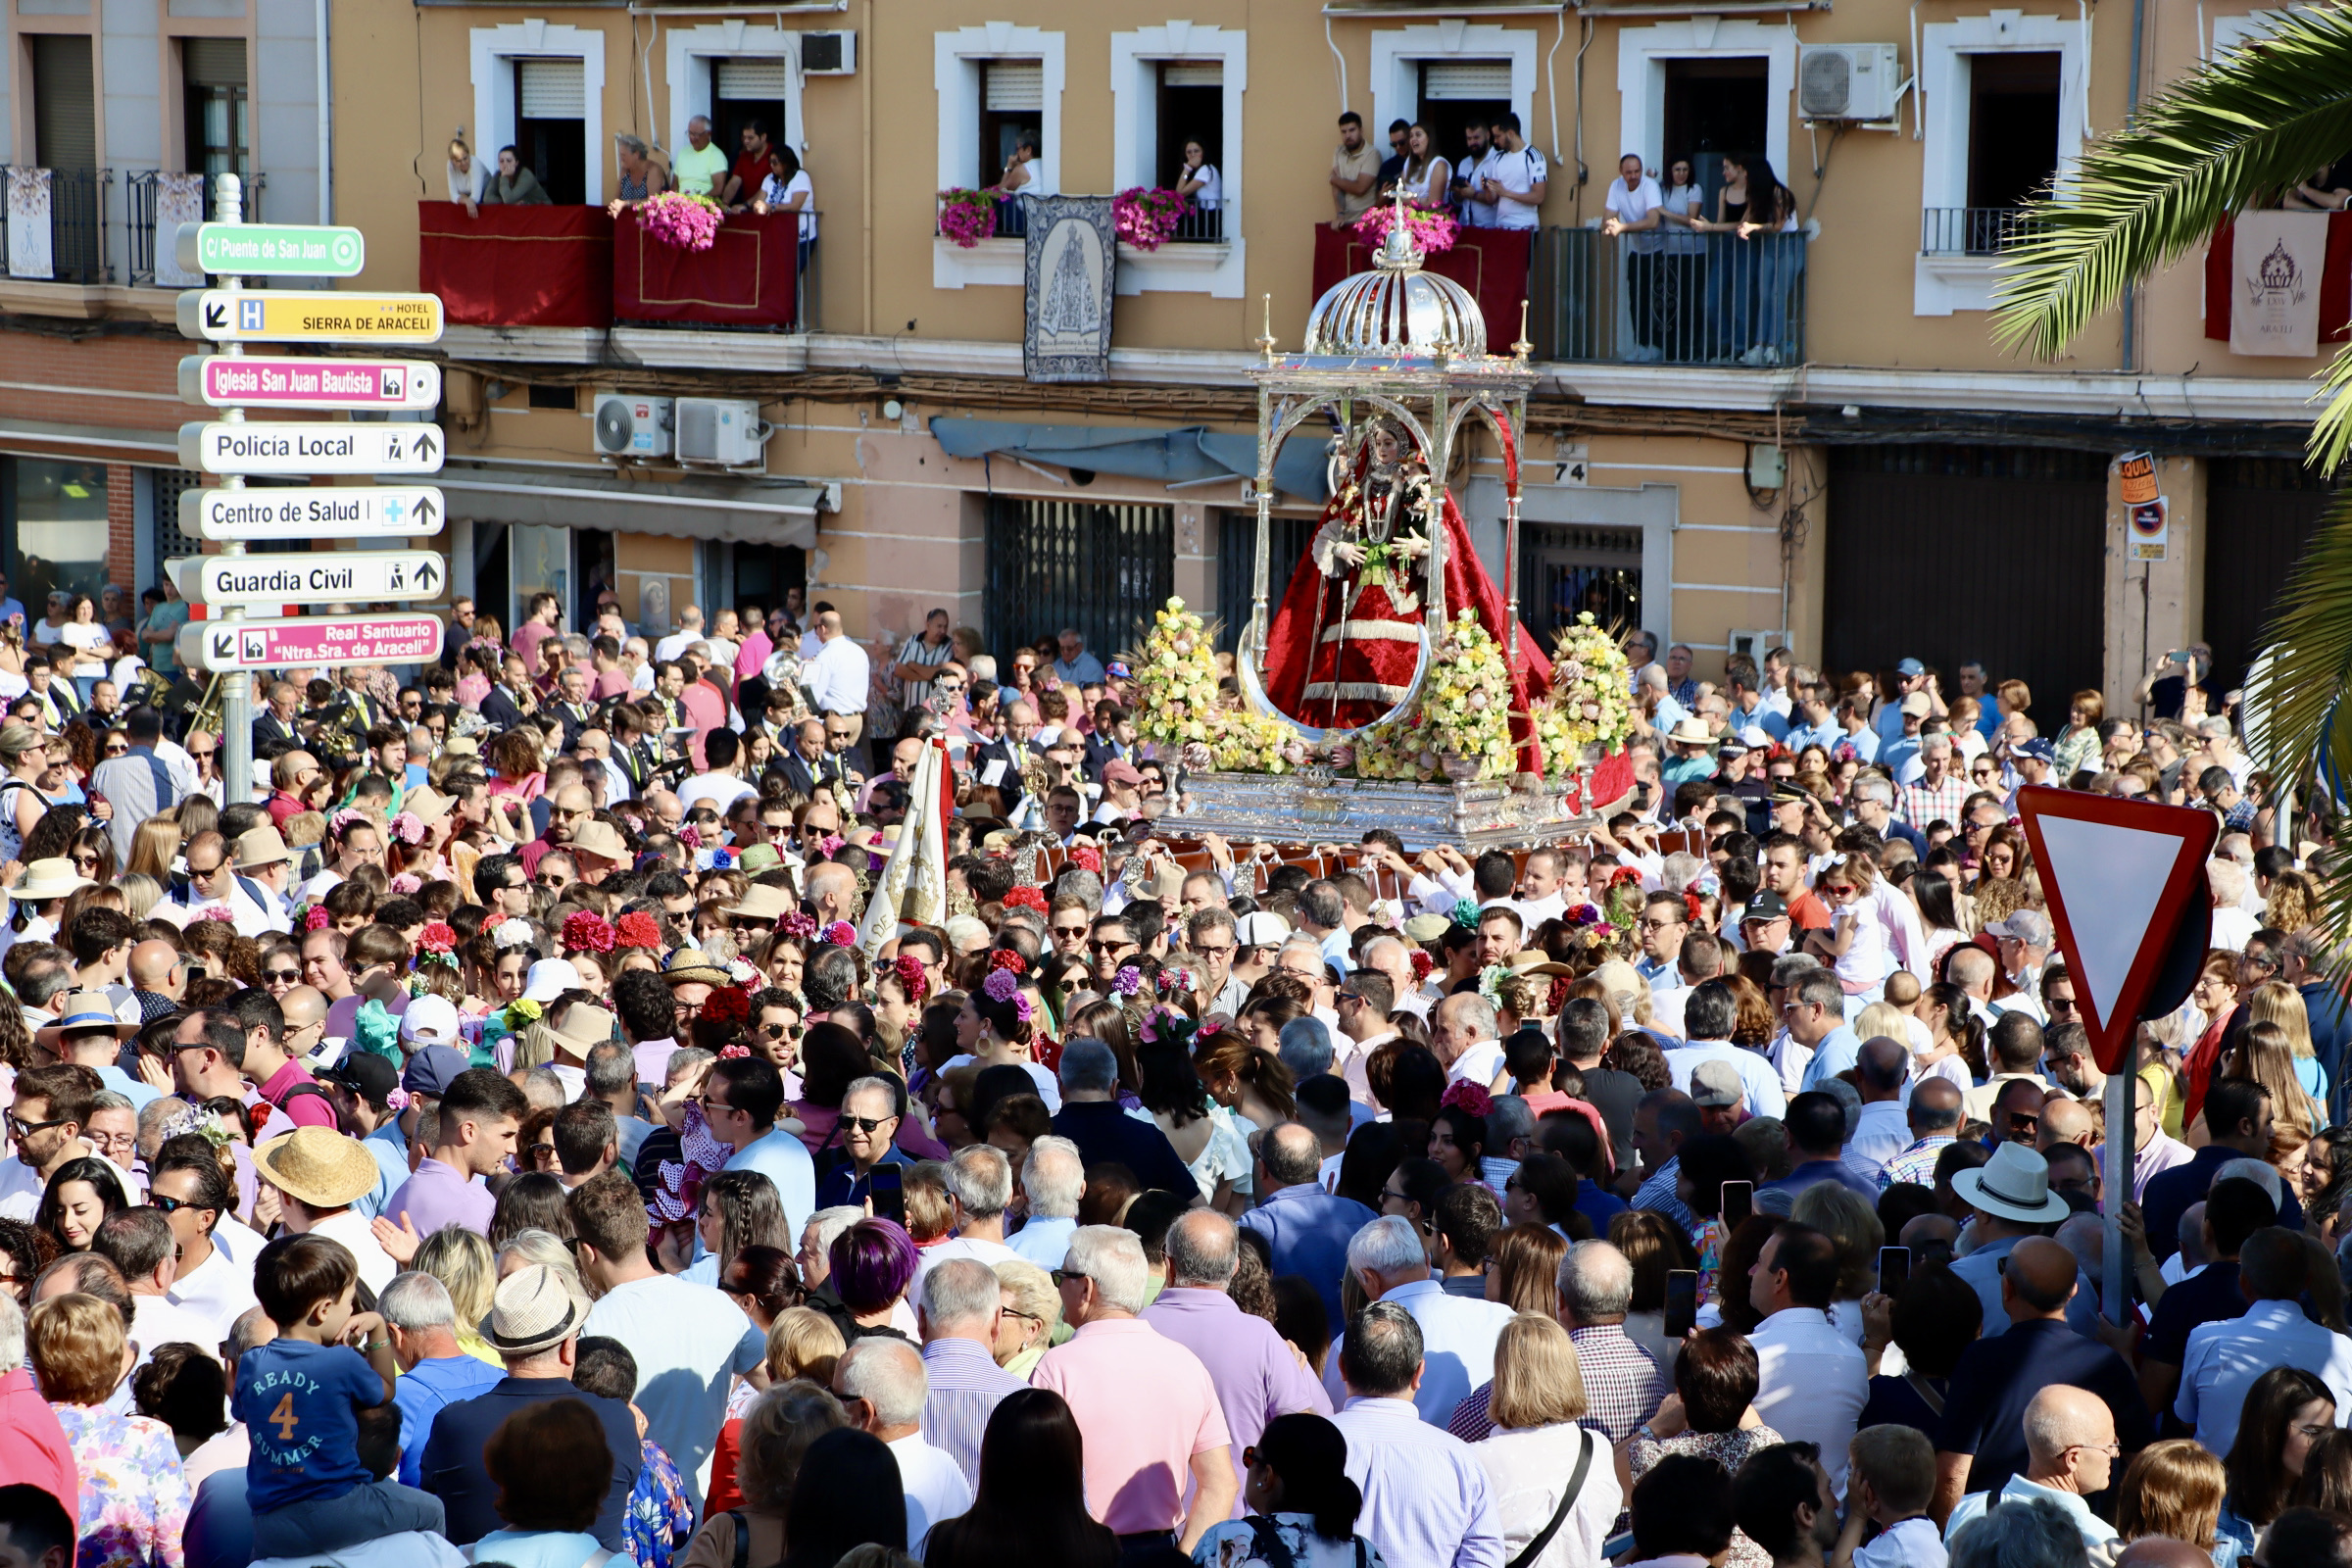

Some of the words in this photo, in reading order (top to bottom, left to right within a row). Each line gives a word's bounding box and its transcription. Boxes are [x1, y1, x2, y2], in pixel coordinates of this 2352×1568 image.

[206, 237, 218, 259] C/
[221, 238, 259, 258] Puente
[262, 239, 275, 258] de
[278, 239, 299, 259] San
[302, 239, 326, 259] Juan
[397, 304, 428, 314] HOTEL
[303, 317, 352, 329] SIERRA
[356, 318, 372, 329] DE
[376, 318, 430, 330] ARACELI
[216, 368, 258, 396] Iglesia
[262, 368, 286, 392] San
[289, 369, 318, 392] Juan
[321, 370, 372, 393] Bautista
[218, 434, 289, 456] Policía
[299, 435, 353, 456] Local
[1556, 463, 1585, 480] 74
[212, 502, 273, 524] Centro
[279, 501, 302, 522] de
[309, 500, 360, 521] Salud
[217, 569, 301, 592] Guardia
[309, 568, 353, 589] Civil
[325, 625, 358, 641] Real
[362, 622, 430, 640] Santuario
[351, 641, 369, 657] de
[253, 1370, 319, 1396] READY
[269, 1392, 299, 1440] 4
